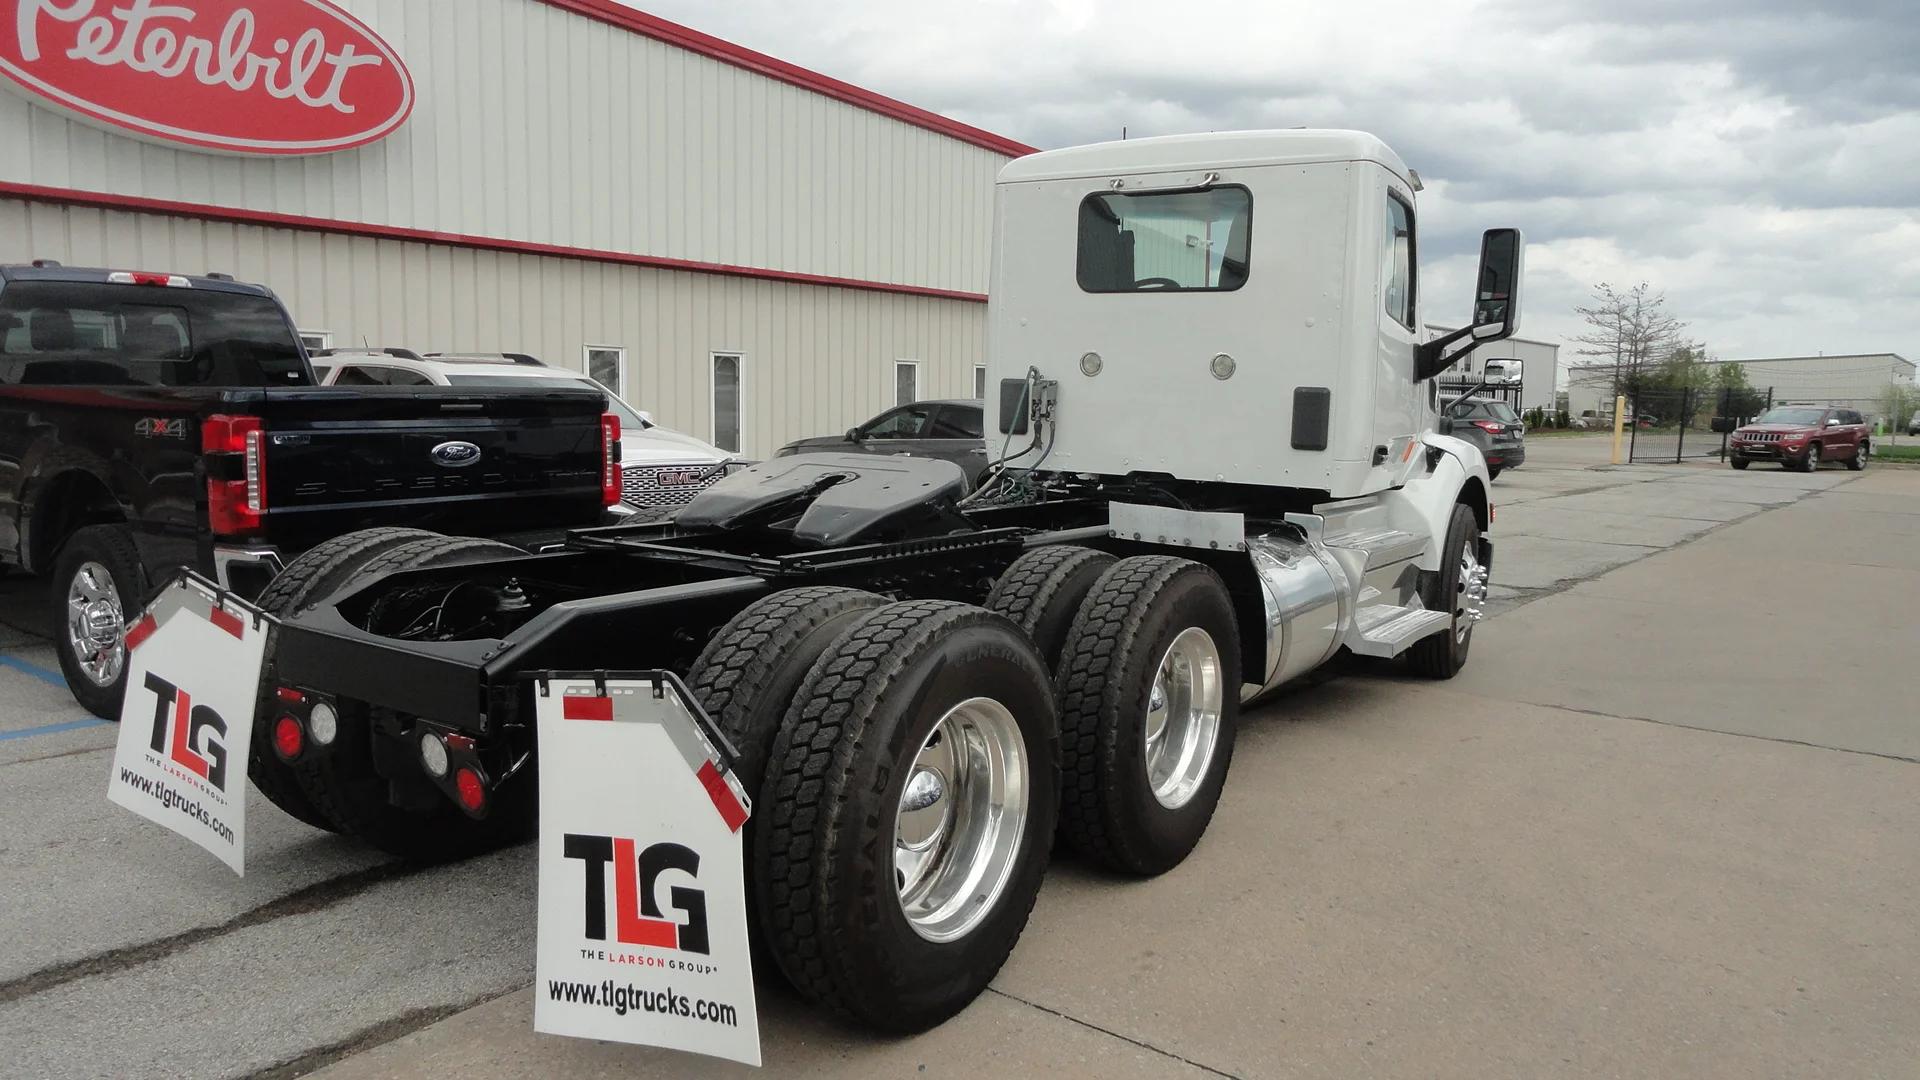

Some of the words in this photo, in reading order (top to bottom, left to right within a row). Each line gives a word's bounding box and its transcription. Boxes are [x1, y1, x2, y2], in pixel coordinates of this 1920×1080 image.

[659, 472, 701, 485] GMC
[144, 670, 228, 793] TLG
[145, 753, 161, 767] THE
[163, 764, 199, 788] LARSON
[120, 766, 235, 846] www.tlgtrucks.com
[563, 832, 711, 956] TLG
[580, 949, 605, 960] THE
[608, 952, 665, 968] LARSON
[549, 979, 738, 1028] www.tlgtrucks.com
